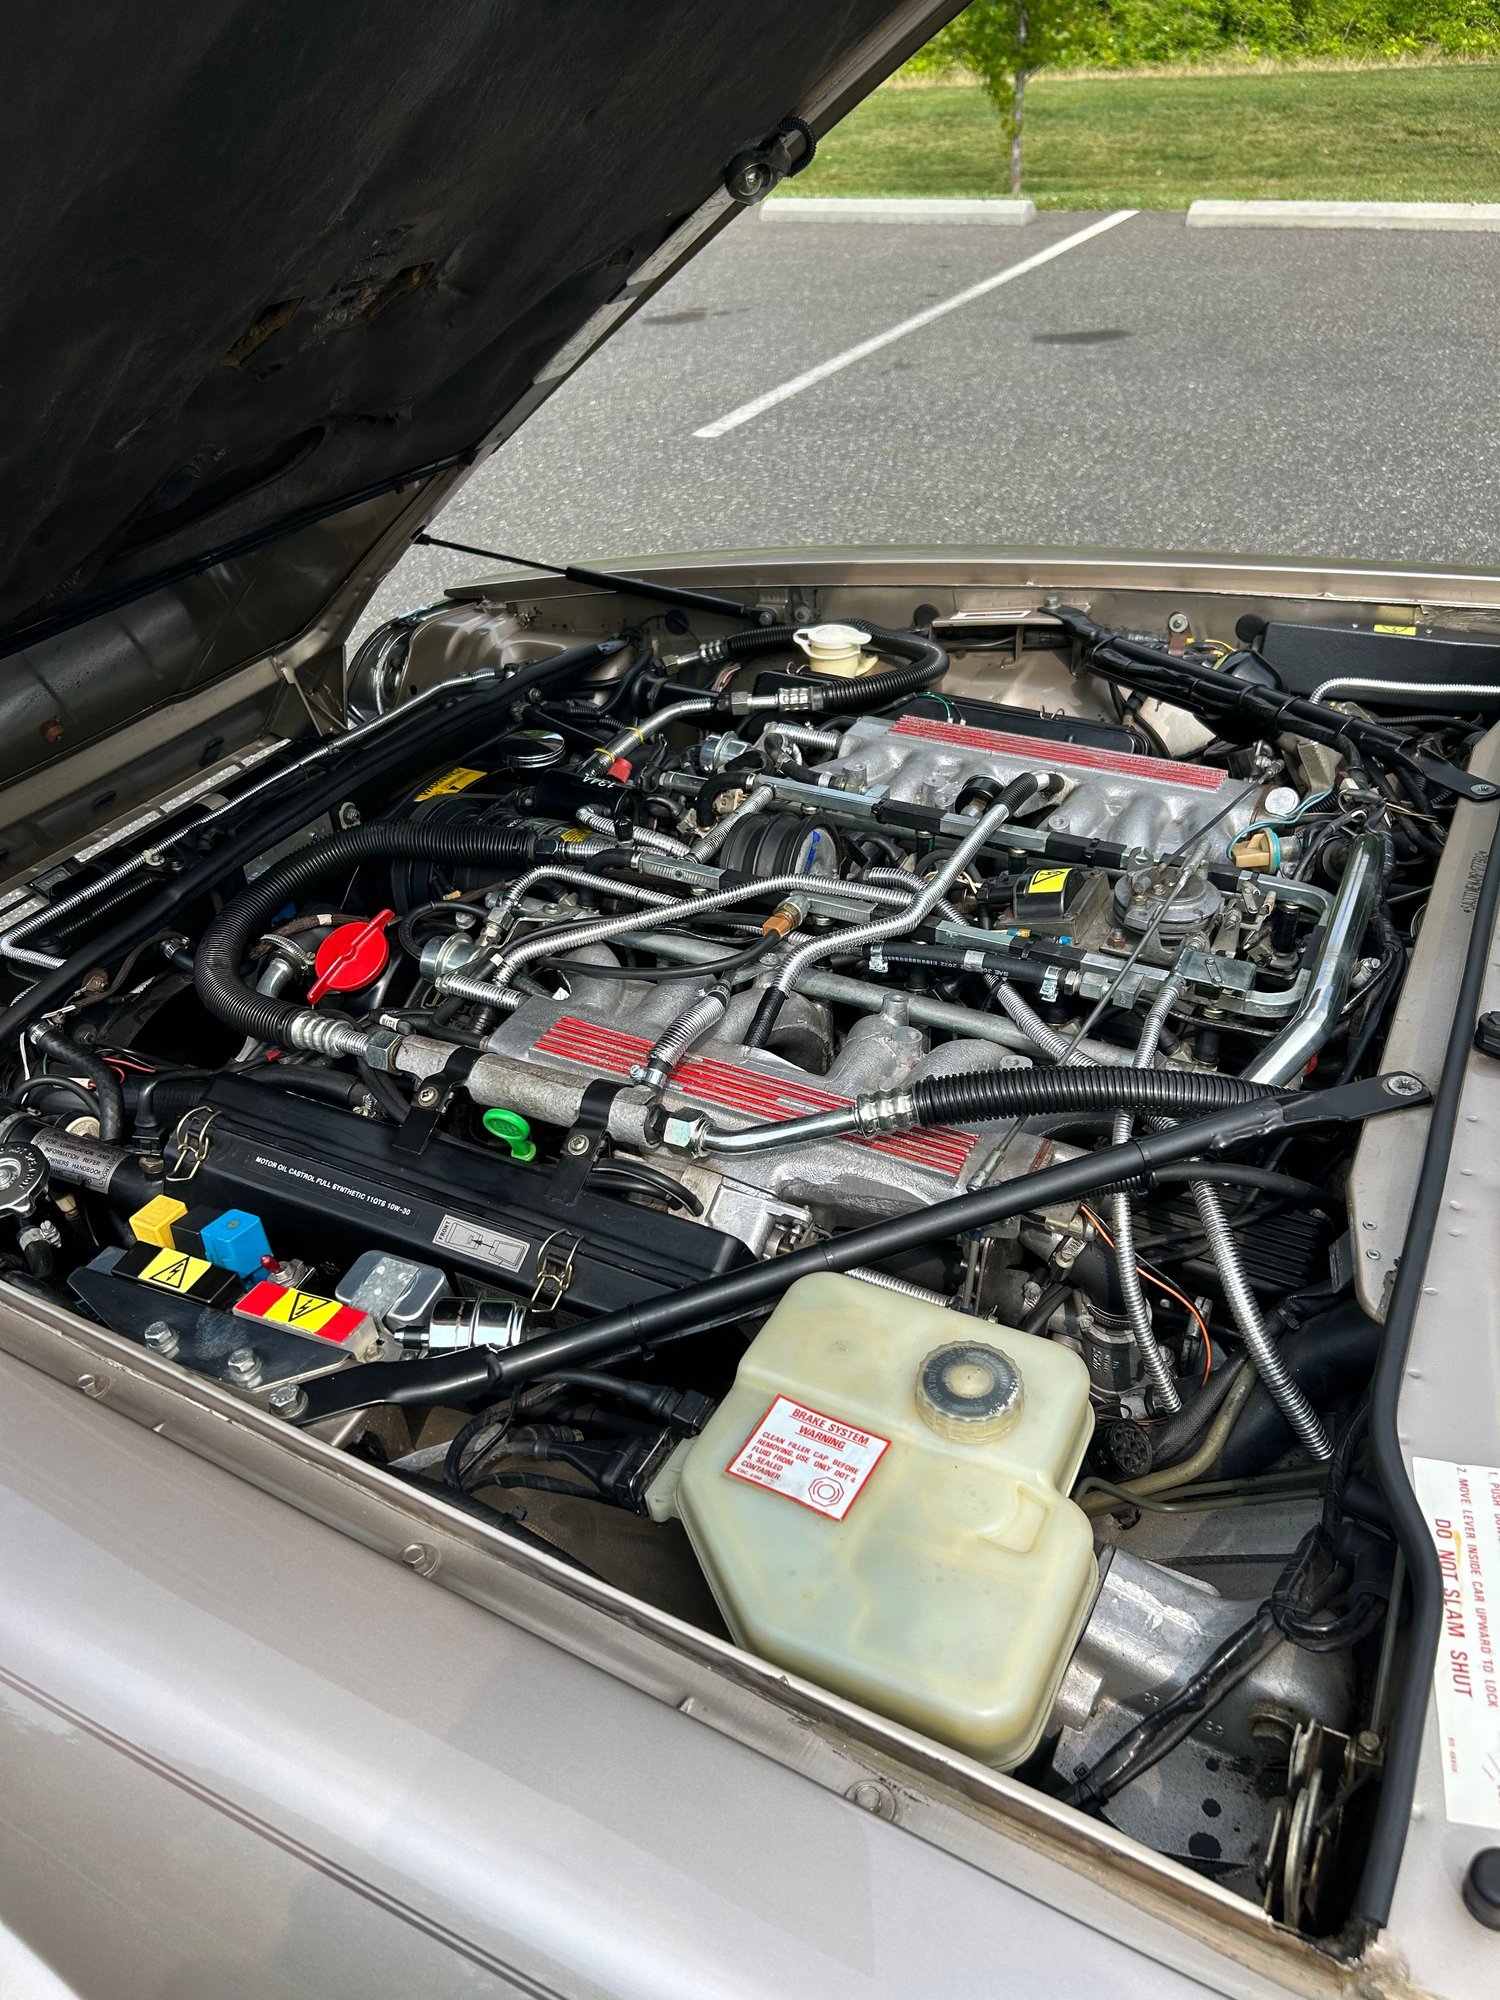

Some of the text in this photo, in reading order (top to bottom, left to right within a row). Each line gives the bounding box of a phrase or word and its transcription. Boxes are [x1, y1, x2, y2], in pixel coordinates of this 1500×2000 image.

[45, 1147, 101, 1166] INFORMATION REFER
[60, 1143, 95, 1156] LUBRICATION
[72, 1163, 101, 1175] HANDBOOK
[255, 1156, 277, 1169] MOTOR
[278, 1164, 287, 1173] OIL
[288, 1168, 315, 1182] CASTROL
[316, 1177, 331, 1188] FULL
[332, 1183, 366, 1200] SYNTHETIC
[438, 1220, 451, 1240] FRONT
[792, 1408, 870, 1445] BRAKE SYSTEM
[798, 1425, 846, 1449] WARNING
[752, 1446, 794, 1466] FLUID FROM
[756, 1438, 794, 1457] REMOVING.
[795, 1453, 810, 1464] USE
[813, 1460, 831, 1472] ONLY
[834, 1470, 850, 1480] DOT
[756, 1457, 783, 1472] SEALED
[762, 1431, 860, 1475] CLEAN FILLER CAP BEFORE
[1459, 1478, 1471, 1504] MOVE
[1489, 1483, 1500, 1506] PUSH
[1463, 1510, 1476, 1539] LEVER
[1466, 1544, 1481, 1575] INSIDE
[1472, 1581, 1485, 1602] CAR
[1434, 1518, 1473, 1698] DO NOT SLAM SHUT
[1476, 1608, 1490, 1654] UPWARD
[1482, 1660, 1494, 1673] TO
[1484, 1680, 1498, 1708] LOCK
